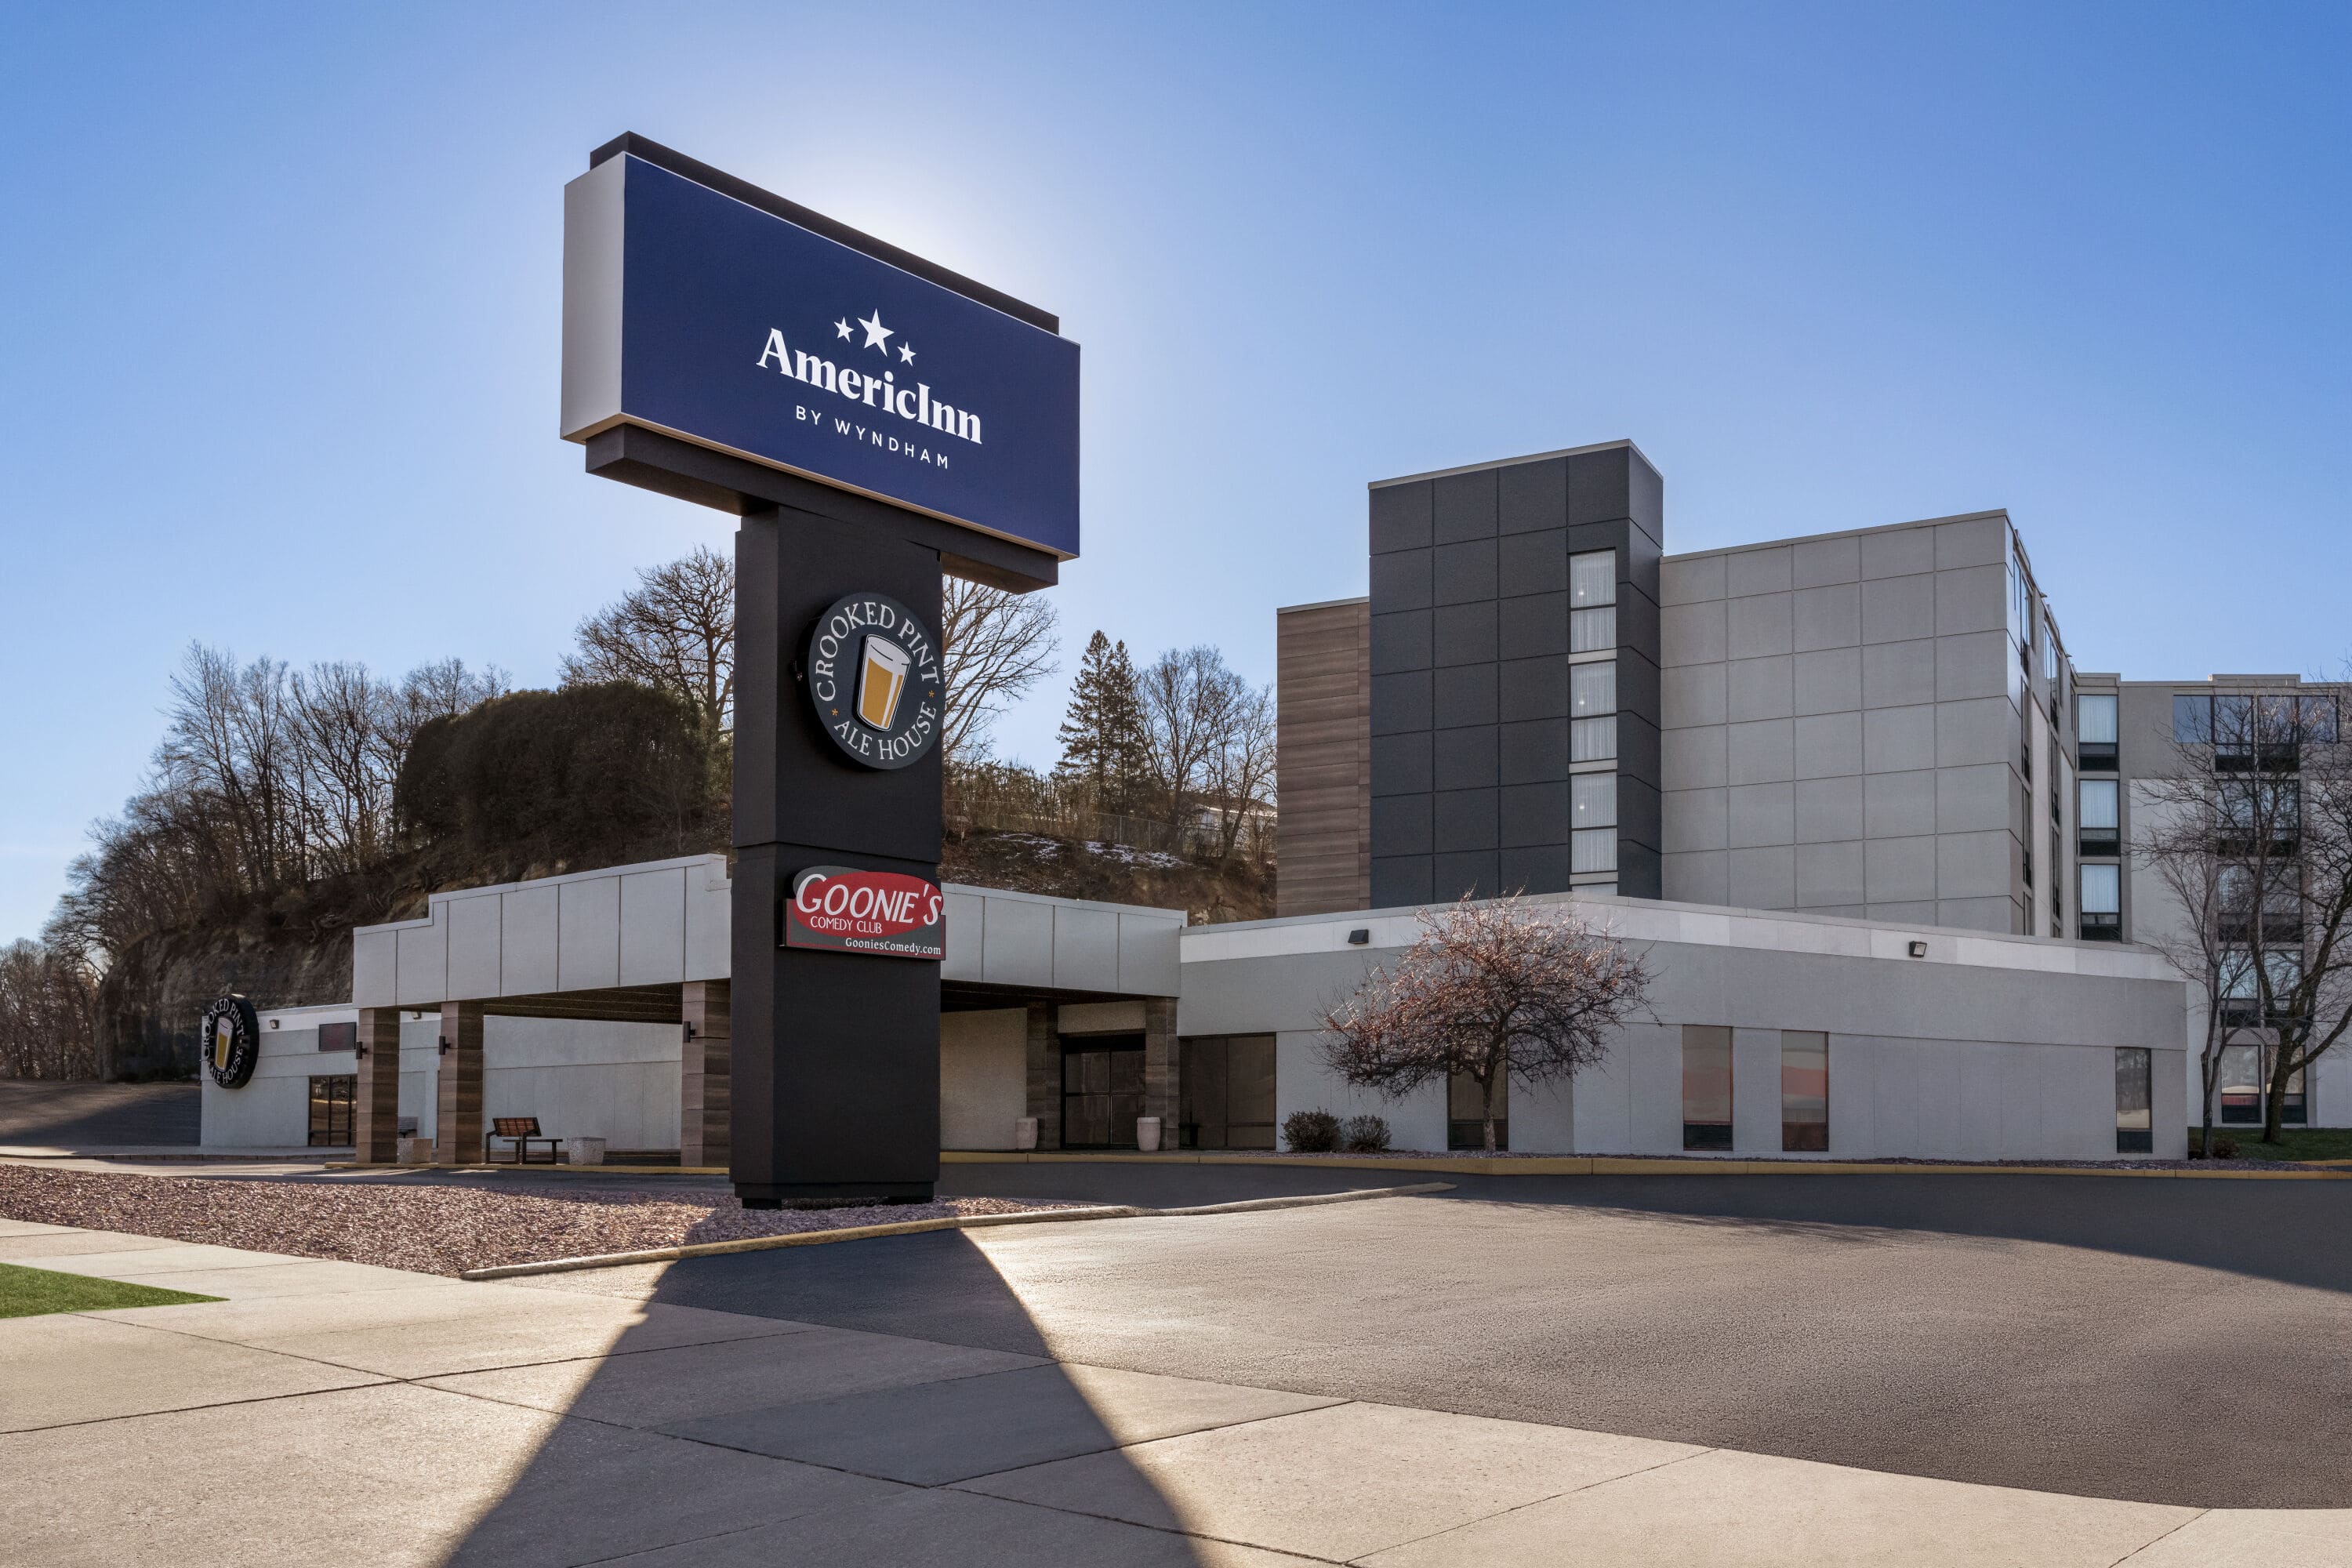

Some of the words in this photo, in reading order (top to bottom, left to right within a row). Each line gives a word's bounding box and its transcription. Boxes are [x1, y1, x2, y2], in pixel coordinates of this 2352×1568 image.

[756, 328, 982, 445] AmericInn
[796, 405, 822, 425] BY
[835, 418, 949, 469] WYNDHAM
[815, 602, 895, 702] CROOKED
[898, 619, 940, 684] PINT
[834, 720, 873, 756] ALE
[878, 702, 937, 760] HOUSE
[810, 916, 853, 931] COMEDY
[856, 920, 883, 934] CLUB
[845, 938, 942, 956] GooniesComedy.com
[204, 998, 230, 1058] CROOKED
[229, 1002, 245, 1036] PINT
[223, 1046, 244, 1084] HOUSE
